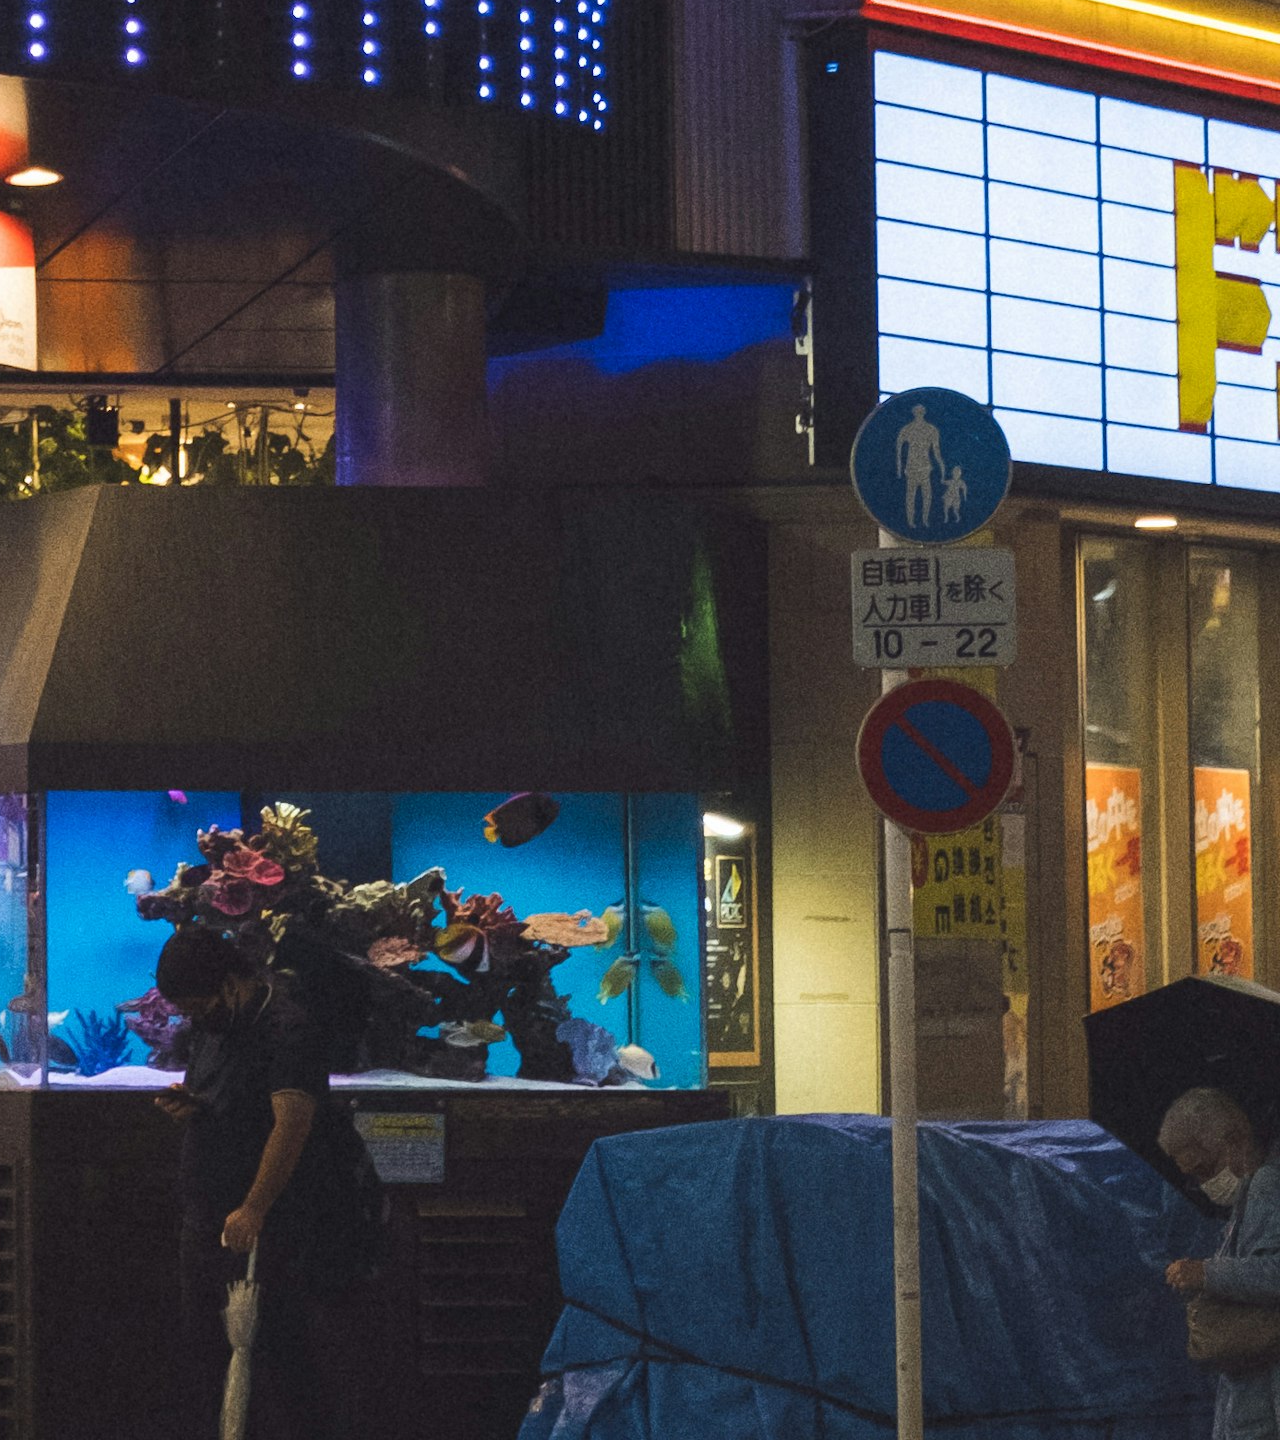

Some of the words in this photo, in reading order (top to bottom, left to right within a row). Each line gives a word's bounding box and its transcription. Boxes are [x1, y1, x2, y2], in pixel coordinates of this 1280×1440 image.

[1173, 159, 1280, 442] F
[861, 557, 932, 588] 自転車
[945, 574, 1005, 606] を除く
[861, 592, 932, 623] 人力車
[873, 629, 904, 660] 10
[955, 628, 999, 659] 22
